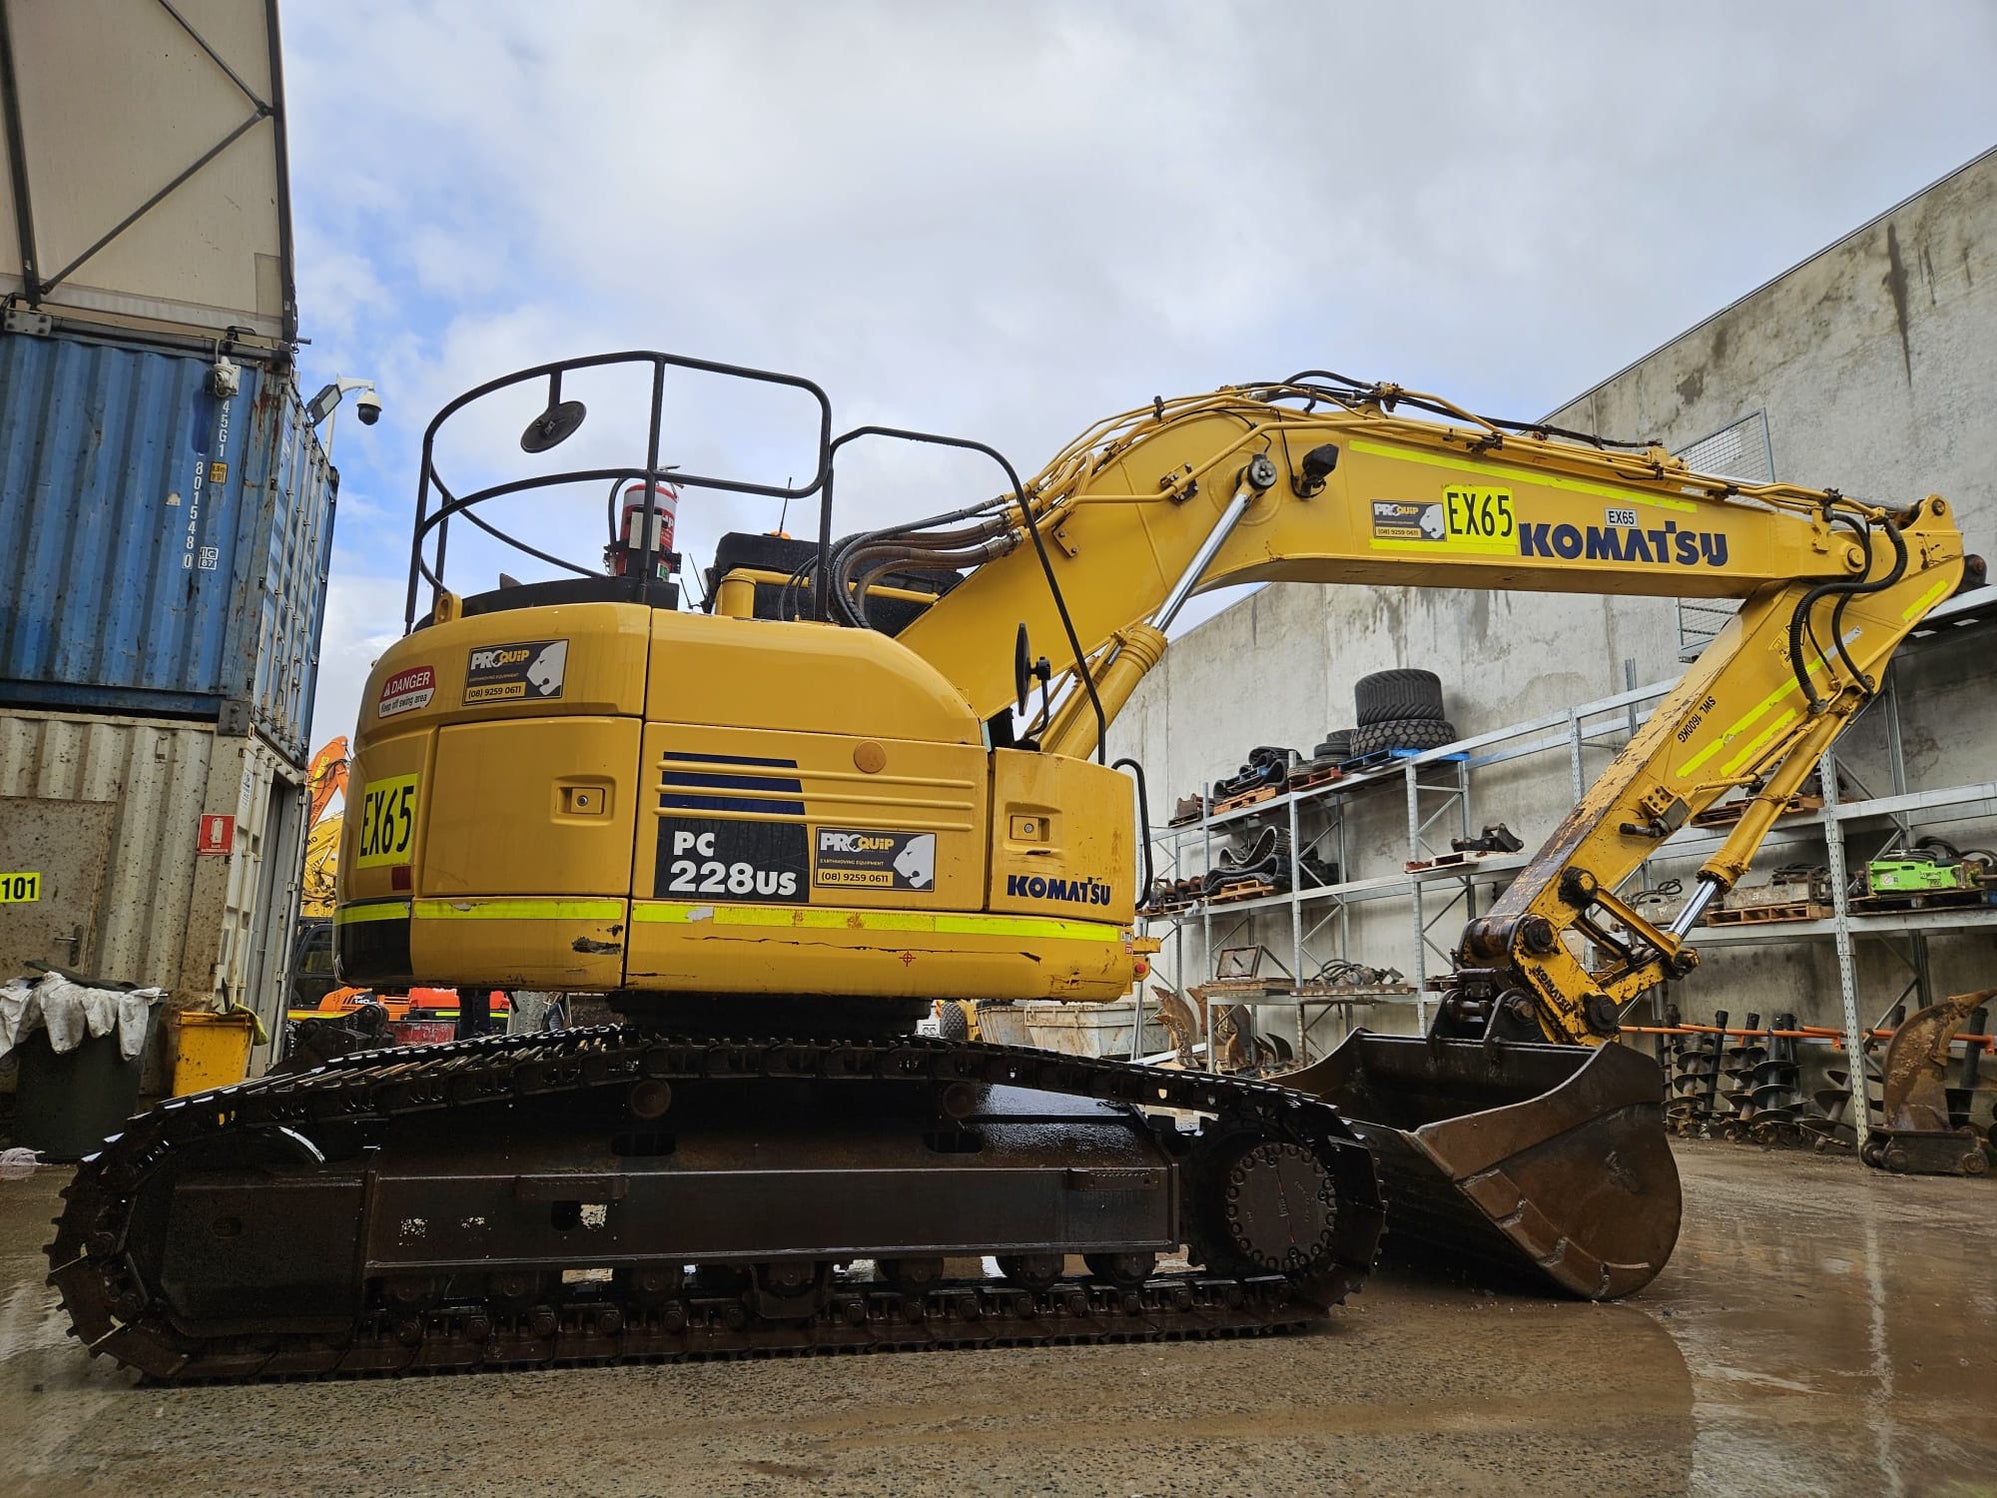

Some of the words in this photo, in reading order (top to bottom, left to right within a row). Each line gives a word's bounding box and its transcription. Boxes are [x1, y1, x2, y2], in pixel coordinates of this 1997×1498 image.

[219, 400, 230, 457] 45G1
[1447, 492, 1512, 537] EX65
[1608, 510, 1635, 525] EX65
[1518, 520, 1728, 567] KOMATSU
[391, 672, 430, 694] DANGER
[469, 689, 482, 699] (08)
[484, 687, 502, 696] 9259
[504, 686, 521, 694] 0611
[415, 694, 427, 703] area
[1699, 696, 1716, 714] SWL
[1677, 713, 1702, 743] 1600KG
[360, 785, 414, 857] EX65
[673, 831, 715, 857] PC
[2, 877, 36, 900] 101
[822, 872, 840, 882] (08)
[843, 873, 867, 882] 9259
[869, 874, 888, 883] 0611
[1007, 875, 1111, 906] KOMATSU
[1533, 965, 1573, 1015] KOMATSU
